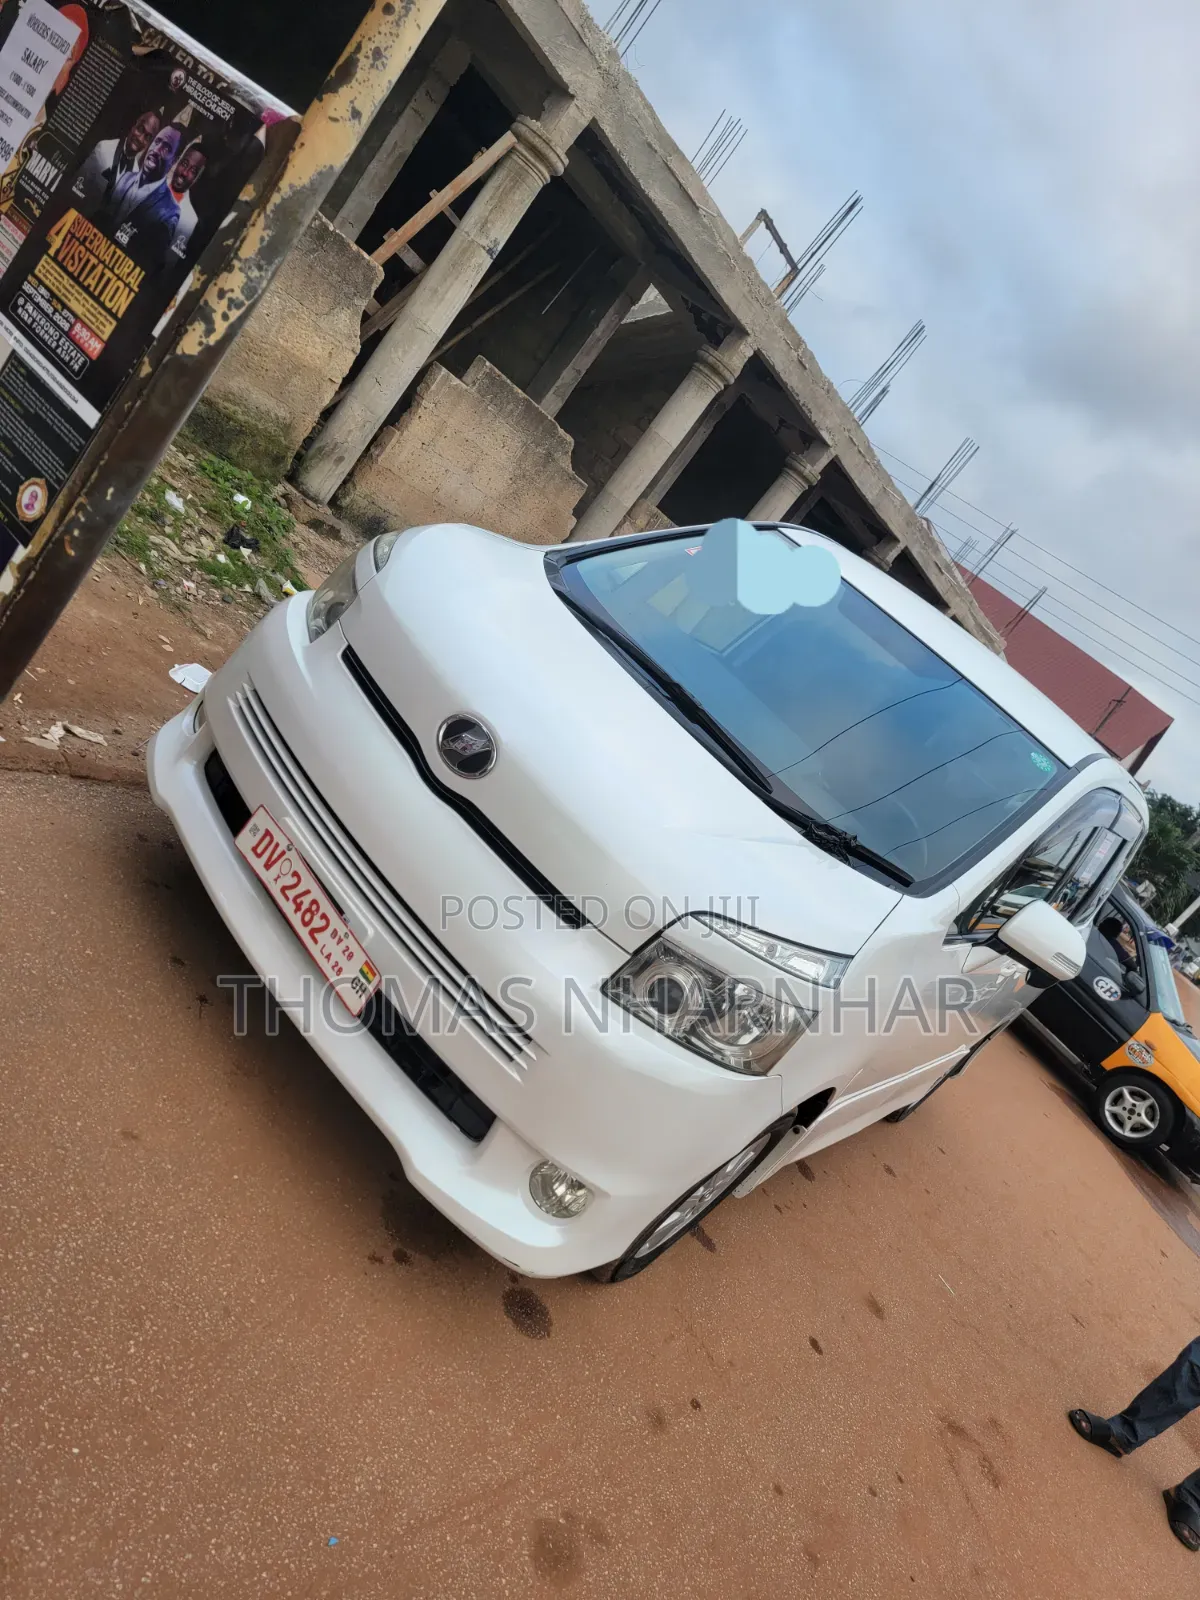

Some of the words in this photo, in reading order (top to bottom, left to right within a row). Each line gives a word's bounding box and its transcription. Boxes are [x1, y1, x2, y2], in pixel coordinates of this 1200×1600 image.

[26, 13, 50, 40] WORKERS
[46, 30, 70, 55] NEEDED
[21, 47, 48, 74] SALARY
[181, 82, 208, 104] MIRACLE
[203, 98, 231, 121] CHURCH
[195, 82, 213, 98] BLOOD
[210, 93, 220, 103] OF
[217, 98, 236, 114] JESUS
[47, 208, 80, 257] 4
[70, 213, 146, 292] SUPERNATURAL
[57, 233, 136, 319] VISITATION
[17, 306, 33, 324] NEAR
[32, 322, 58, 350] FORMER
[70, 360, 80, 373] FM
[24, 303, 60, 340] PANKRONO
[59, 338, 86, 365] ESTATE
[89, 336, 102, 351] AM
[251, 828, 287, 871] DV
[279, 870, 330, 945] 2482
[319, 944, 332, 964] LA
[330, 928, 344, 946] DV
[351, 975, 368, 999] GH
[1095, 978, 1118, 999] GH
